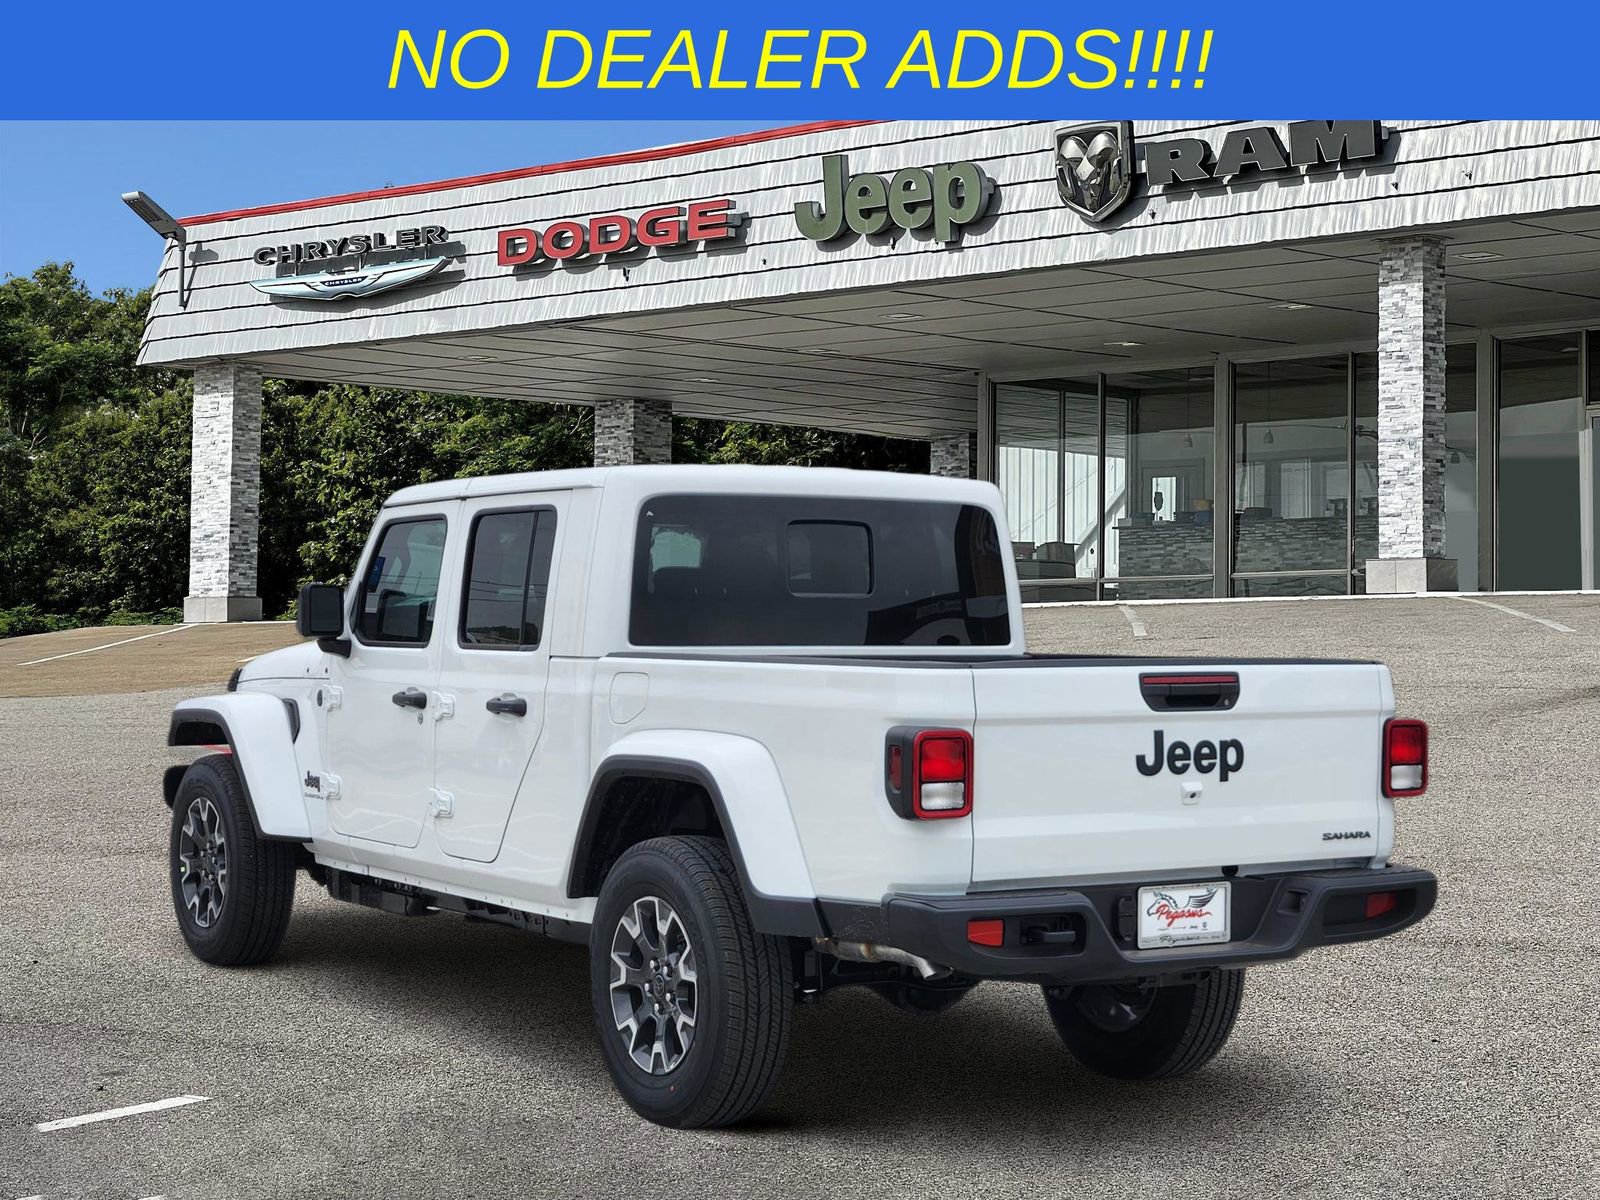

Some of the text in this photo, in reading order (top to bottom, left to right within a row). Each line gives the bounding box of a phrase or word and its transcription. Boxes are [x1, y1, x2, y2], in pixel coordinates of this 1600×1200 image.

[1146, 119, 1376, 185] RAM
[795, 154, 986, 243] Jeep
[253, 225, 449, 266] CHRYSLER
[498, 199, 736, 266] DODGE
[1135, 729, 1245, 783] Jeep
[1322, 831, 1372, 841] SAHARA
[1155, 903, 1213, 928] Pegasus
